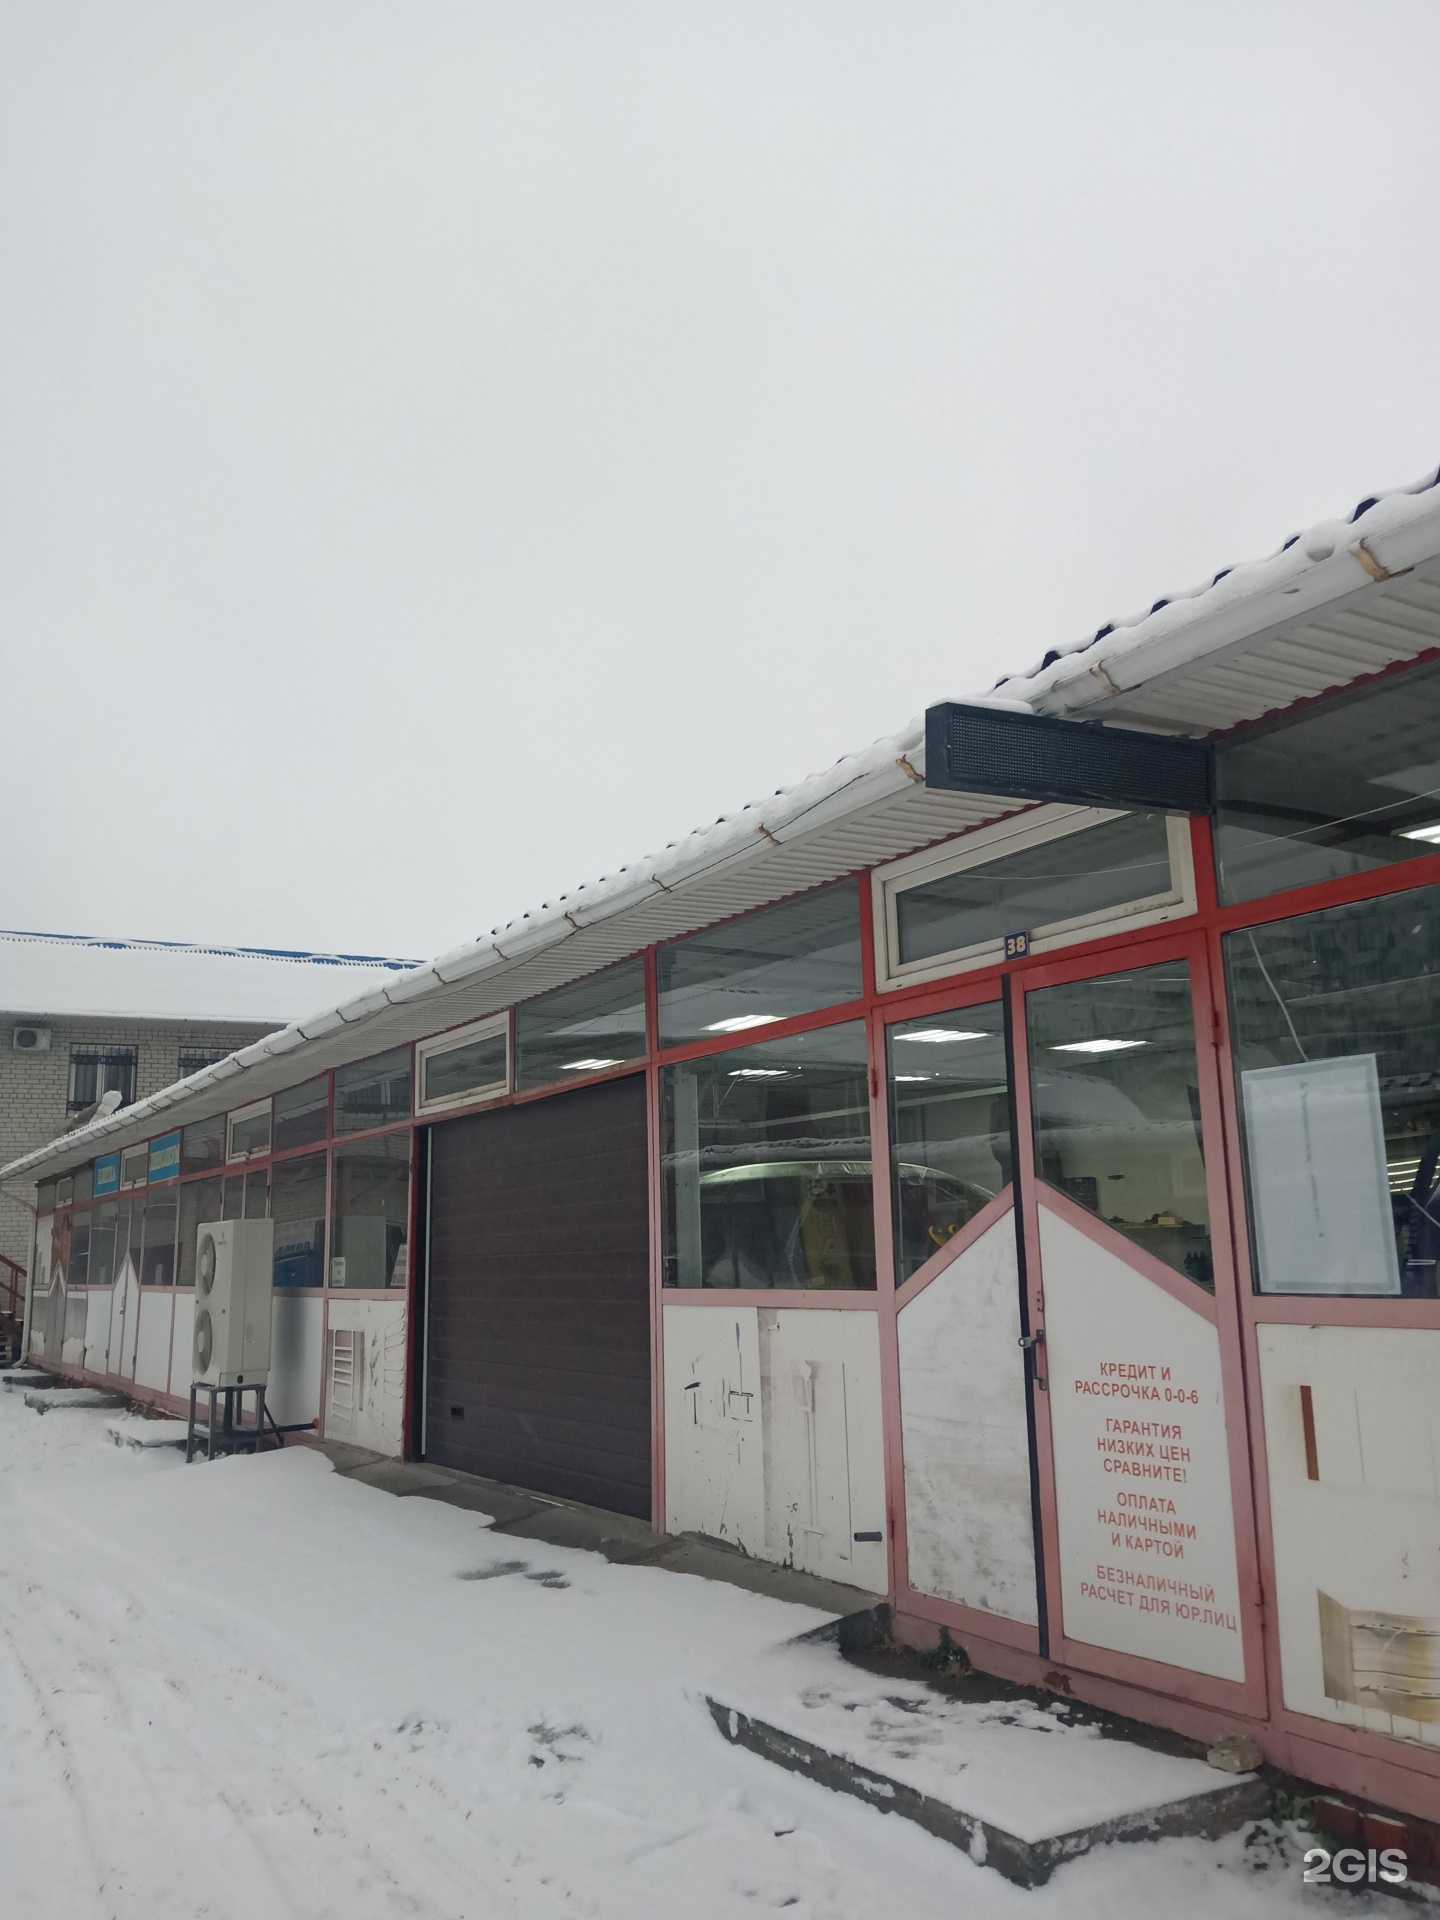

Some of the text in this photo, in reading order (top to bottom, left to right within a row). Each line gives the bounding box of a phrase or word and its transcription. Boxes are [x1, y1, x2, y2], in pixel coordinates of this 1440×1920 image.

[1007, 935, 1026, 956] 38
[1100, 1362, 1172, 1381] КРЕДИТ И
[1075, 1380, 1200, 1404] РАССРОЧКА 0-0-6
[1106, 1418, 1182, 1440] ГАРАНТИЯ
[1097, 1437, 1191, 1463] НИЗКИХ ЦЕН
[1103, 1458, 1187, 1483] СРАВНИТЕ!
[1117, 1492, 1177, 1515] ОПЛАТА
[1097, 1509, 1198, 1540] НАЛИЧНЫМИ
[1111, 1532, 1185, 1559] И КАРТОЙ
[1096, 1565, 1216, 1603] БЕЗНАЛИЧНЫЙ
[1080, 1582, 1135, 1607] РАСЧЕТ
[1139, 1595, 1171, 1615] ДЛЯ
